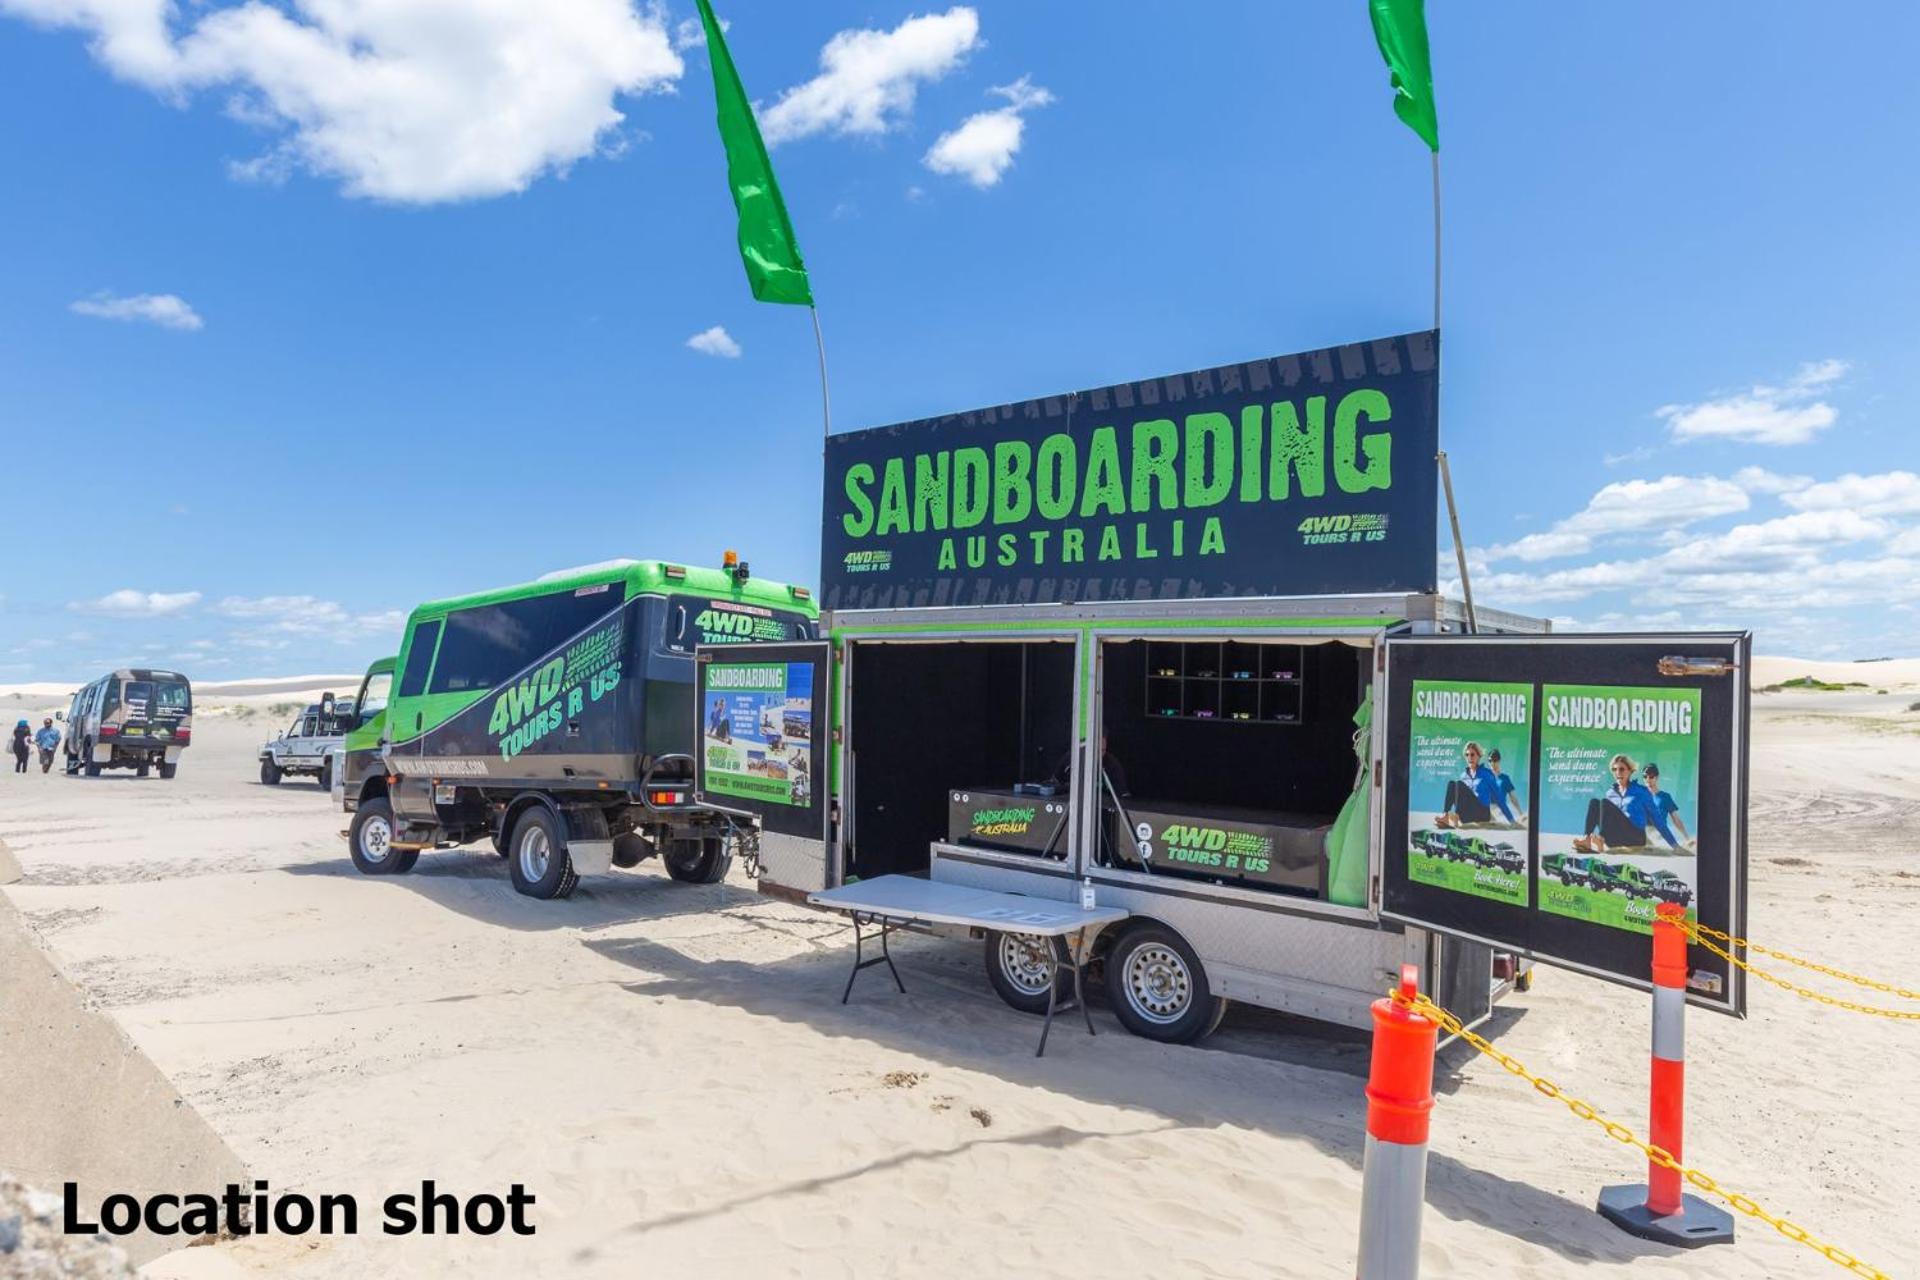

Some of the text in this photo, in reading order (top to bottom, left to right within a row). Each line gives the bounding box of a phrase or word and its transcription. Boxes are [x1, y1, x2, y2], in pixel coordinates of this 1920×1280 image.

[843, 389, 1392, 538] SANDBOARDING
[1297, 515, 1352, 534] 4WD
[1303, 530, 1387, 545] TOURS R US
[937, 516, 1226, 571] AUSTRALIA
[844, 551, 873, 564] 4WD
[695, 610, 754, 636] 4WD
[709, 668, 783, 688] SANDBOARDING
[488, 656, 564, 735] 4WD
[1416, 690, 1526, 724] SANDBOARDING
[499, 662, 622, 762] TOURS R US
[1547, 695, 1692, 735] SANDBOARDING
[984, 822, 1028, 835] AUSTRALIA
[1160, 824, 1227, 851] 4WD
[1167, 847, 1270, 873] TOURS R US
